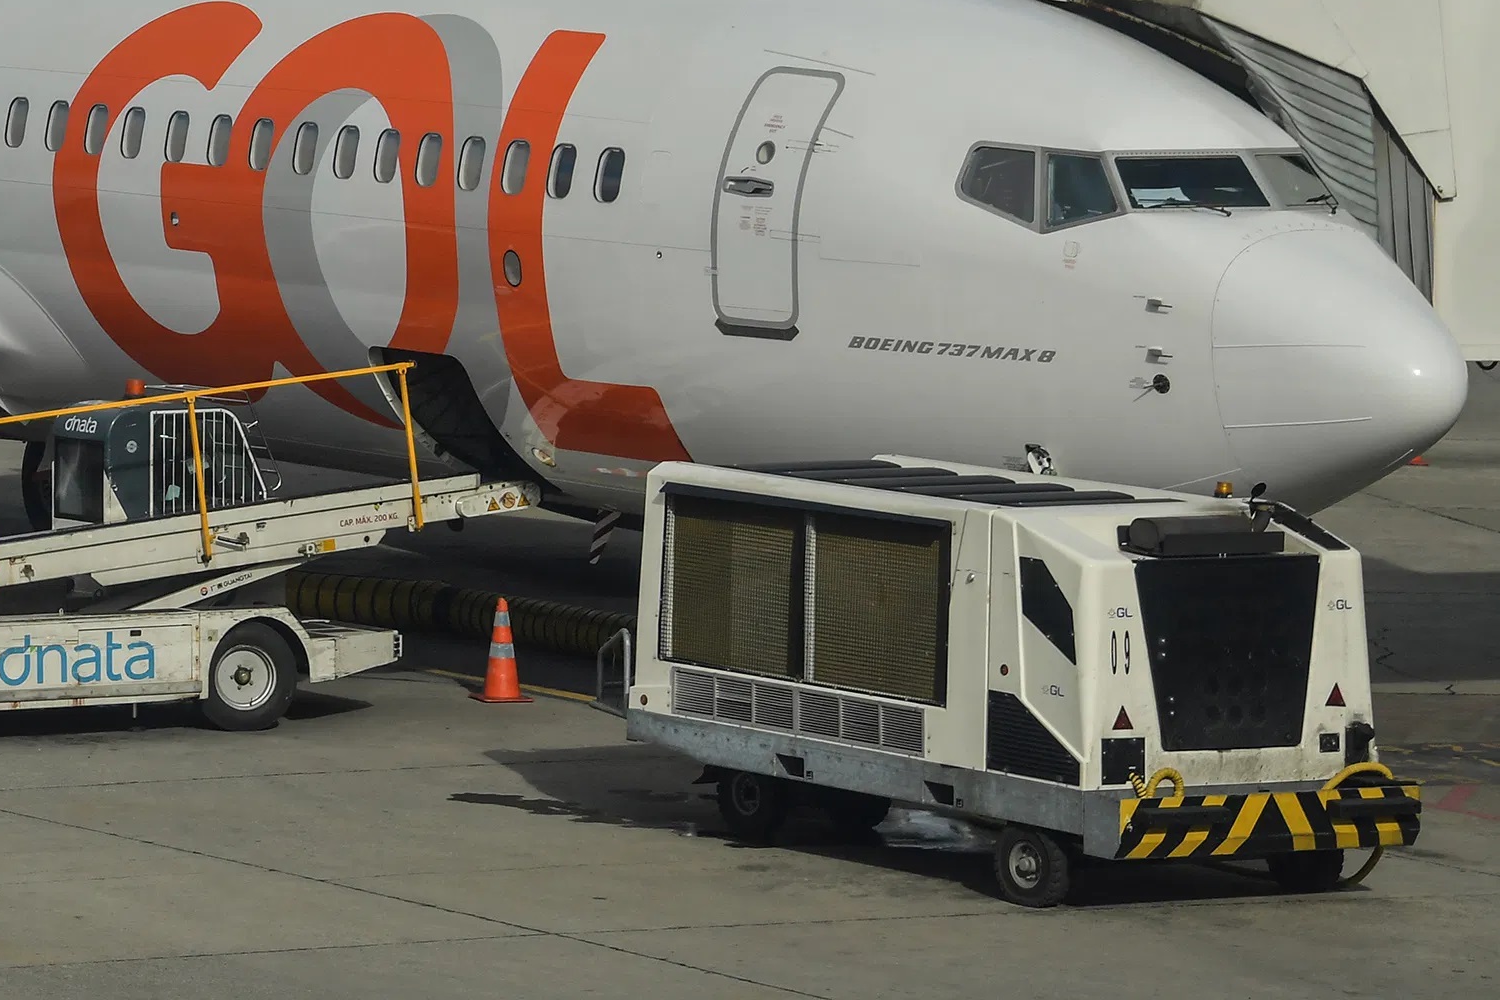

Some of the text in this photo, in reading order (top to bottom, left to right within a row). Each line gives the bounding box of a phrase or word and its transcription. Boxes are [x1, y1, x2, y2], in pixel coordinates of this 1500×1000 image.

[52, 0, 694, 464] GOL
[848, 336, 1056, 363] BOEING 737 MAX 8
[64, 415, 98, 434] dnata
[374, 514, 387, 522] 200
[1336, 599, 1352, 610] GL
[1117, 607, 1133, 618] GL
[1111, 630, 1130, 675] 09
[1049, 685, 1065, 697] GL
